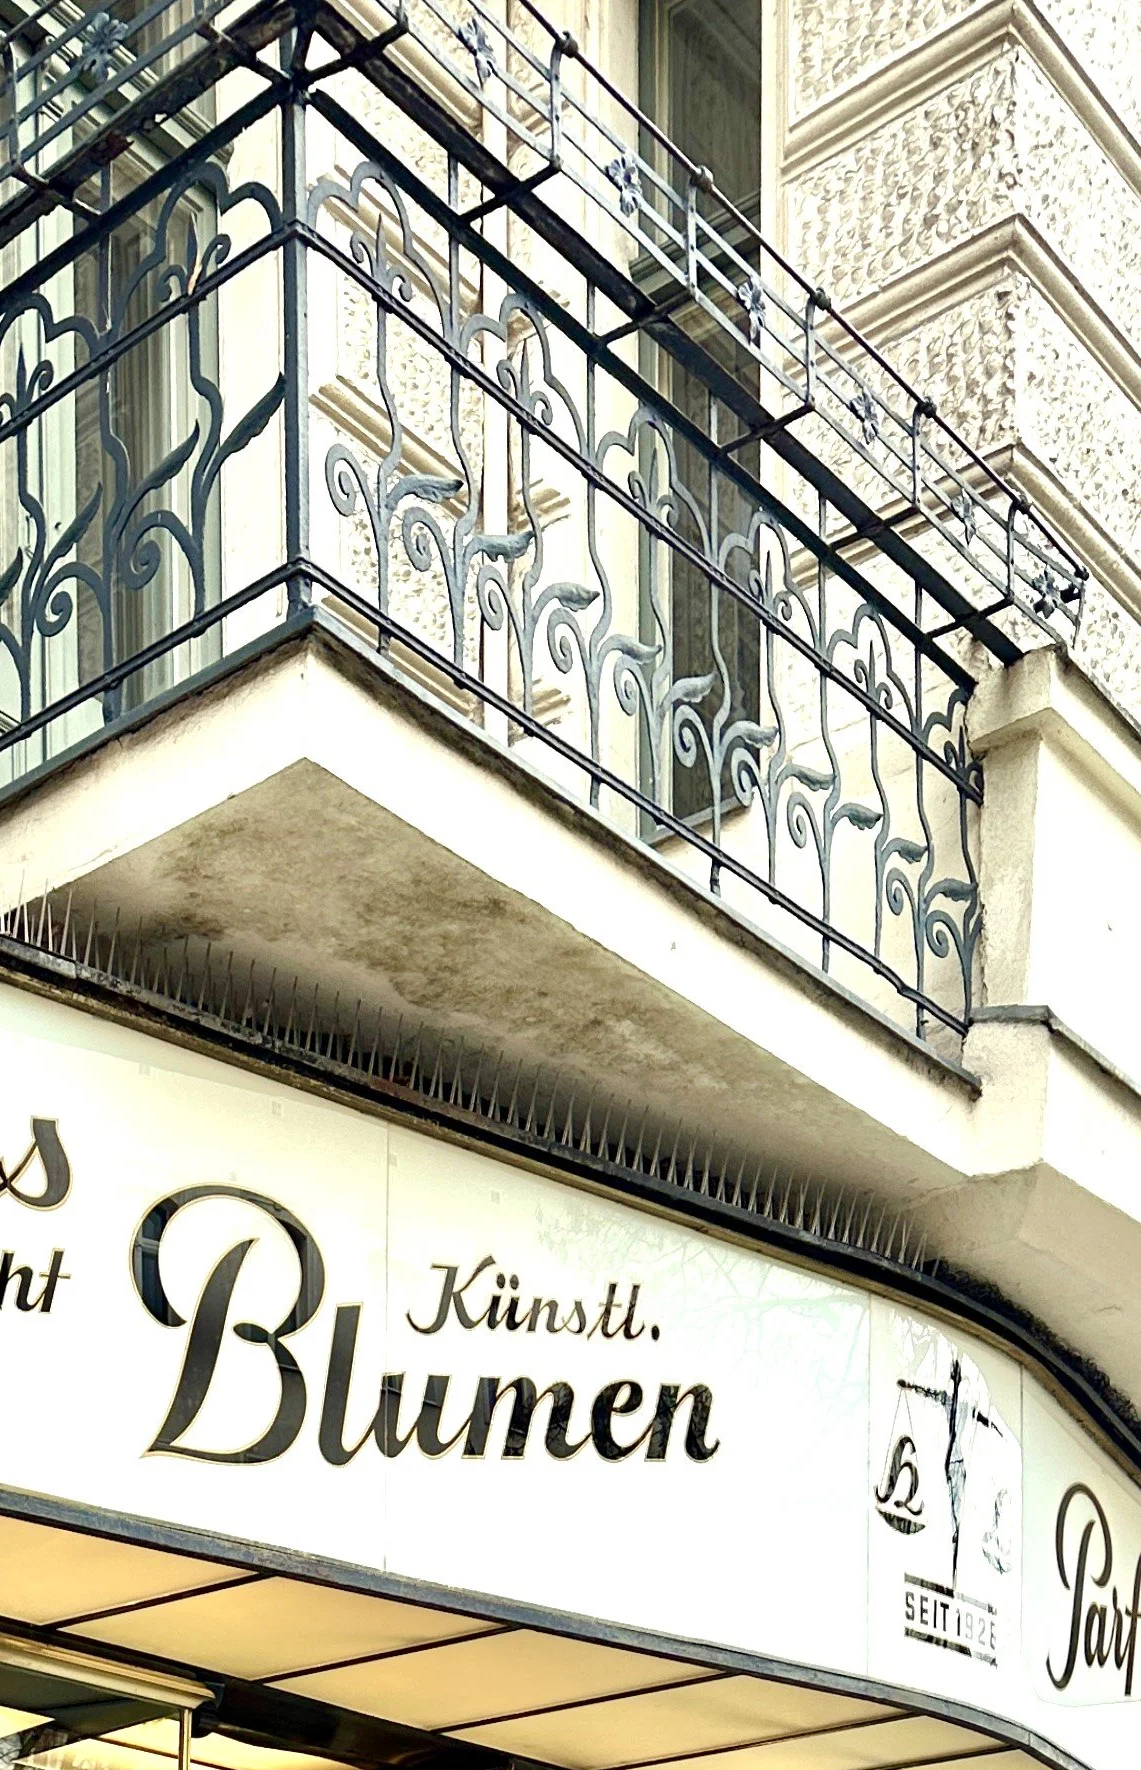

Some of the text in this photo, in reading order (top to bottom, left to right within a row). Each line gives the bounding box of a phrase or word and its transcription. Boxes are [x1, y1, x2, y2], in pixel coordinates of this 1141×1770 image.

[128, 1183, 721, 1467] Blumen
[405, 1254, 662, 1344] Künstl.
[904, 1591, 950, 1632] SEIT
